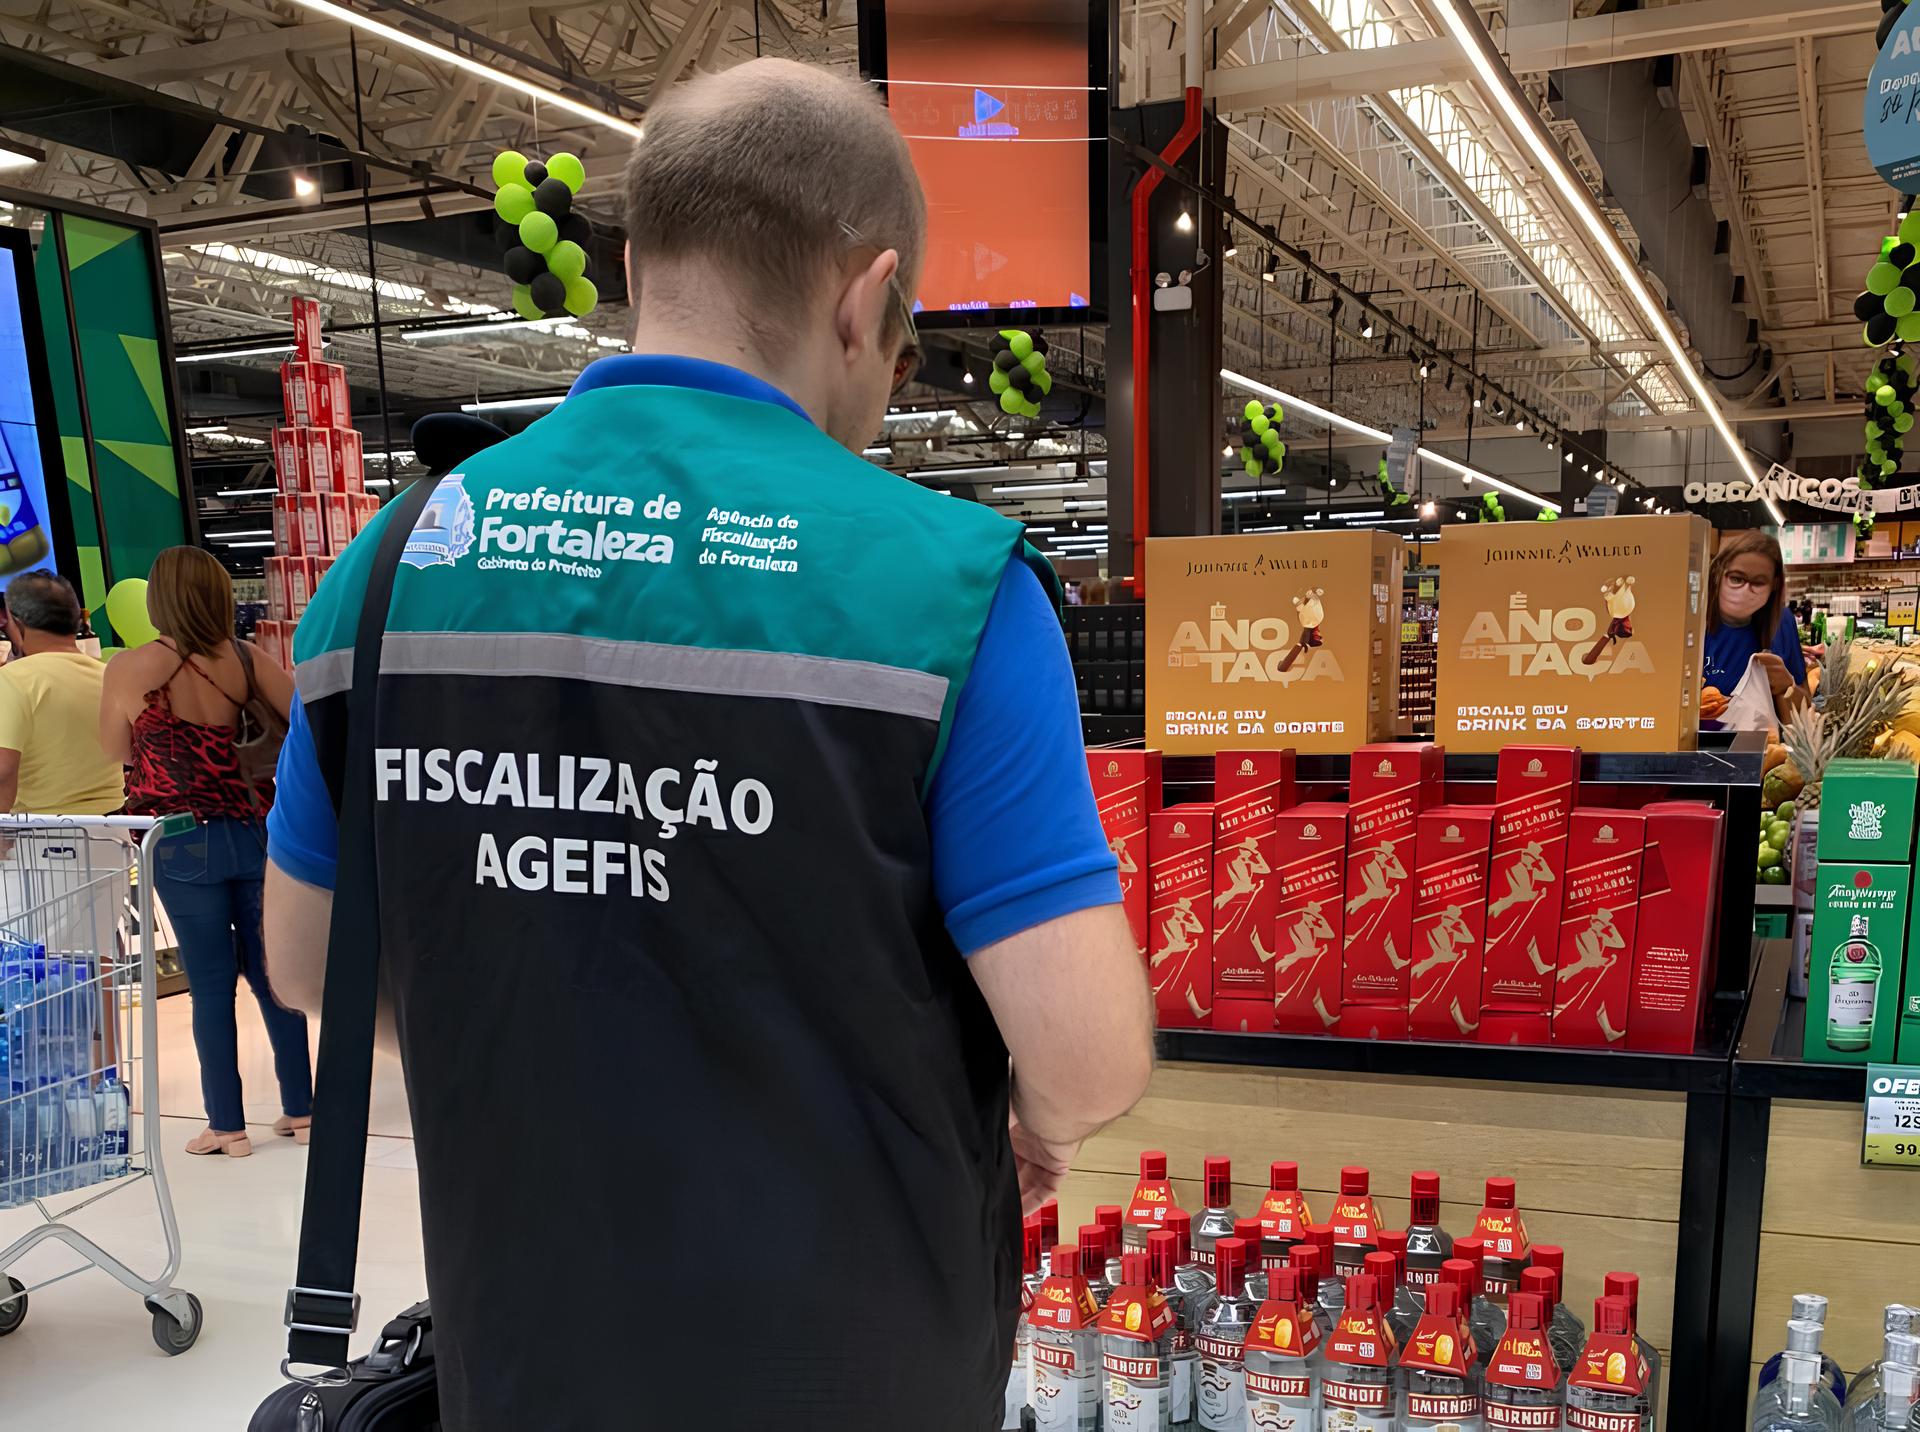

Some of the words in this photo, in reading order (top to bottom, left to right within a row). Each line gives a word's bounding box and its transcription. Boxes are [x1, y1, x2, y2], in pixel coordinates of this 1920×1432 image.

[485, 486, 635, 516] Prefeitura
[643, 493, 682, 520] de
[478, 516, 674, 564] Fortaleza
[1165, 722, 1229, 735] DRINK
[1237, 722, 1265, 734] DA
[1457, 718, 1527, 731] DRINK
[1536, 718, 1566, 730] DA
[375, 748, 774, 839] FISCALIZAÇÃO
[475, 833, 671, 902] AGEFIS
